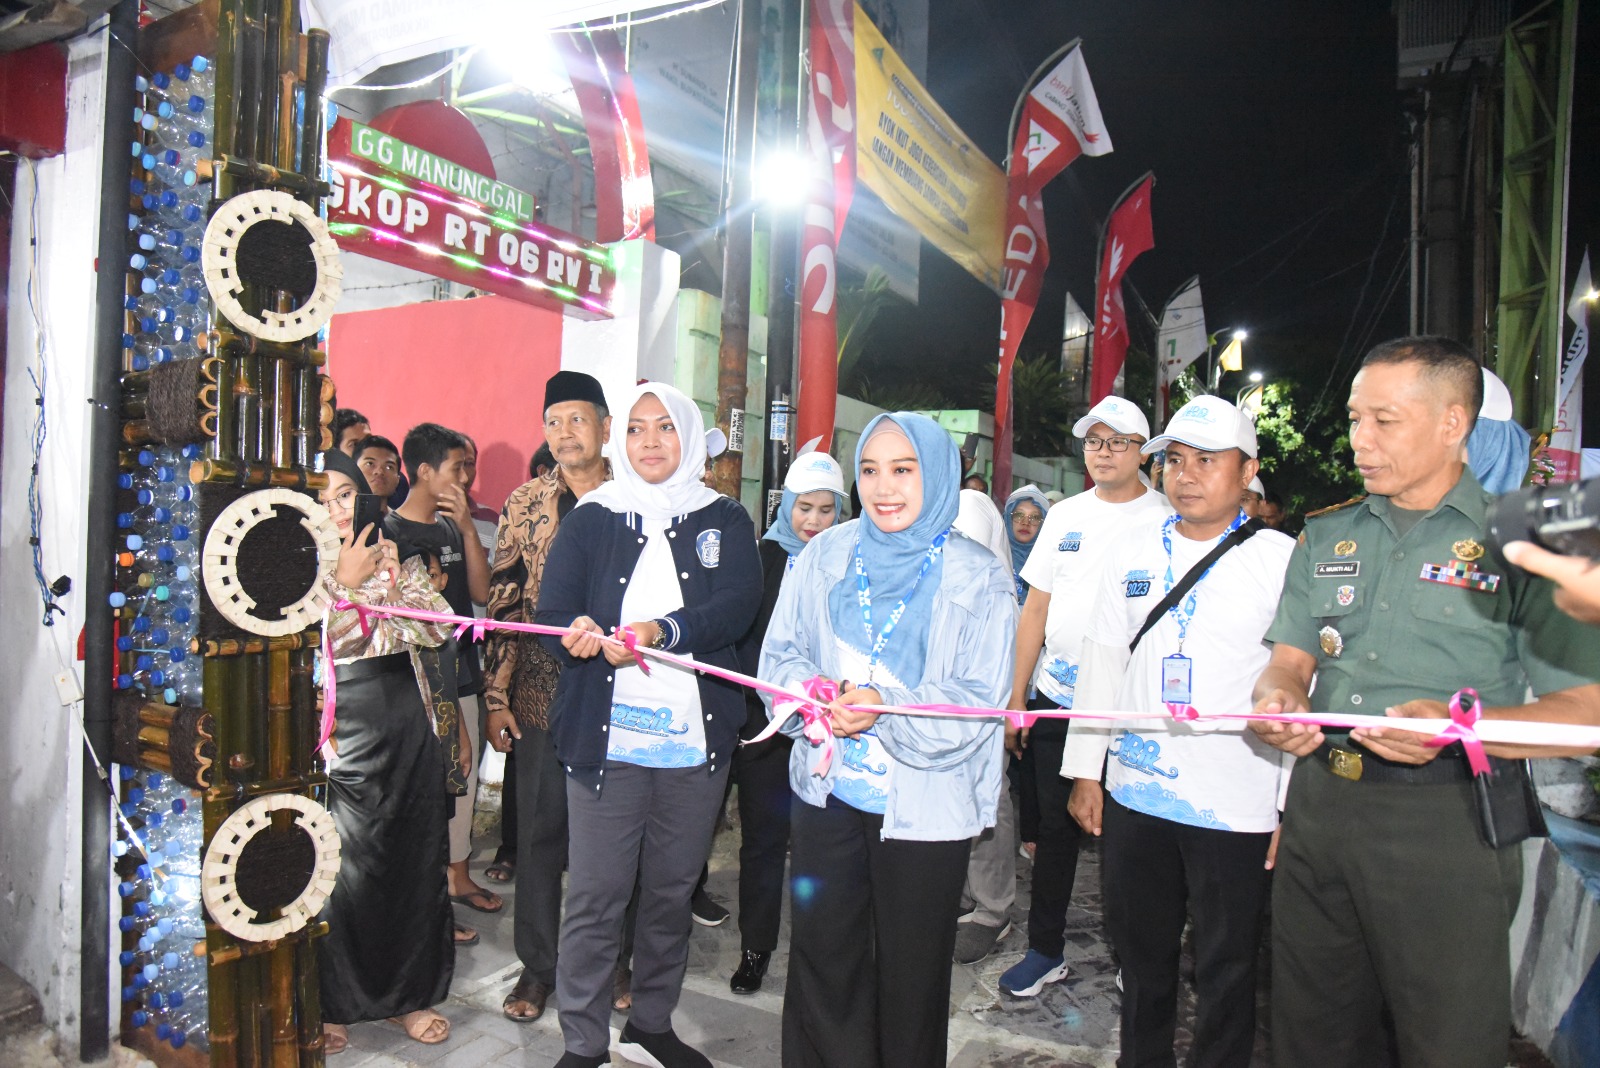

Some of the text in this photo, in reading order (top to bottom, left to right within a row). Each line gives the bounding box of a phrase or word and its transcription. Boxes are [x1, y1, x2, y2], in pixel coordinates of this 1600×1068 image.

[358, 128, 530, 220] GG MANUNGGAL
[444, 212, 491, 256] RT
[499, 232, 540, 274] 06
[546, 250, 582, 288] RW
[1059, 540, 1081, 551] 2023
[1126, 581, 1150, 596] 2023
